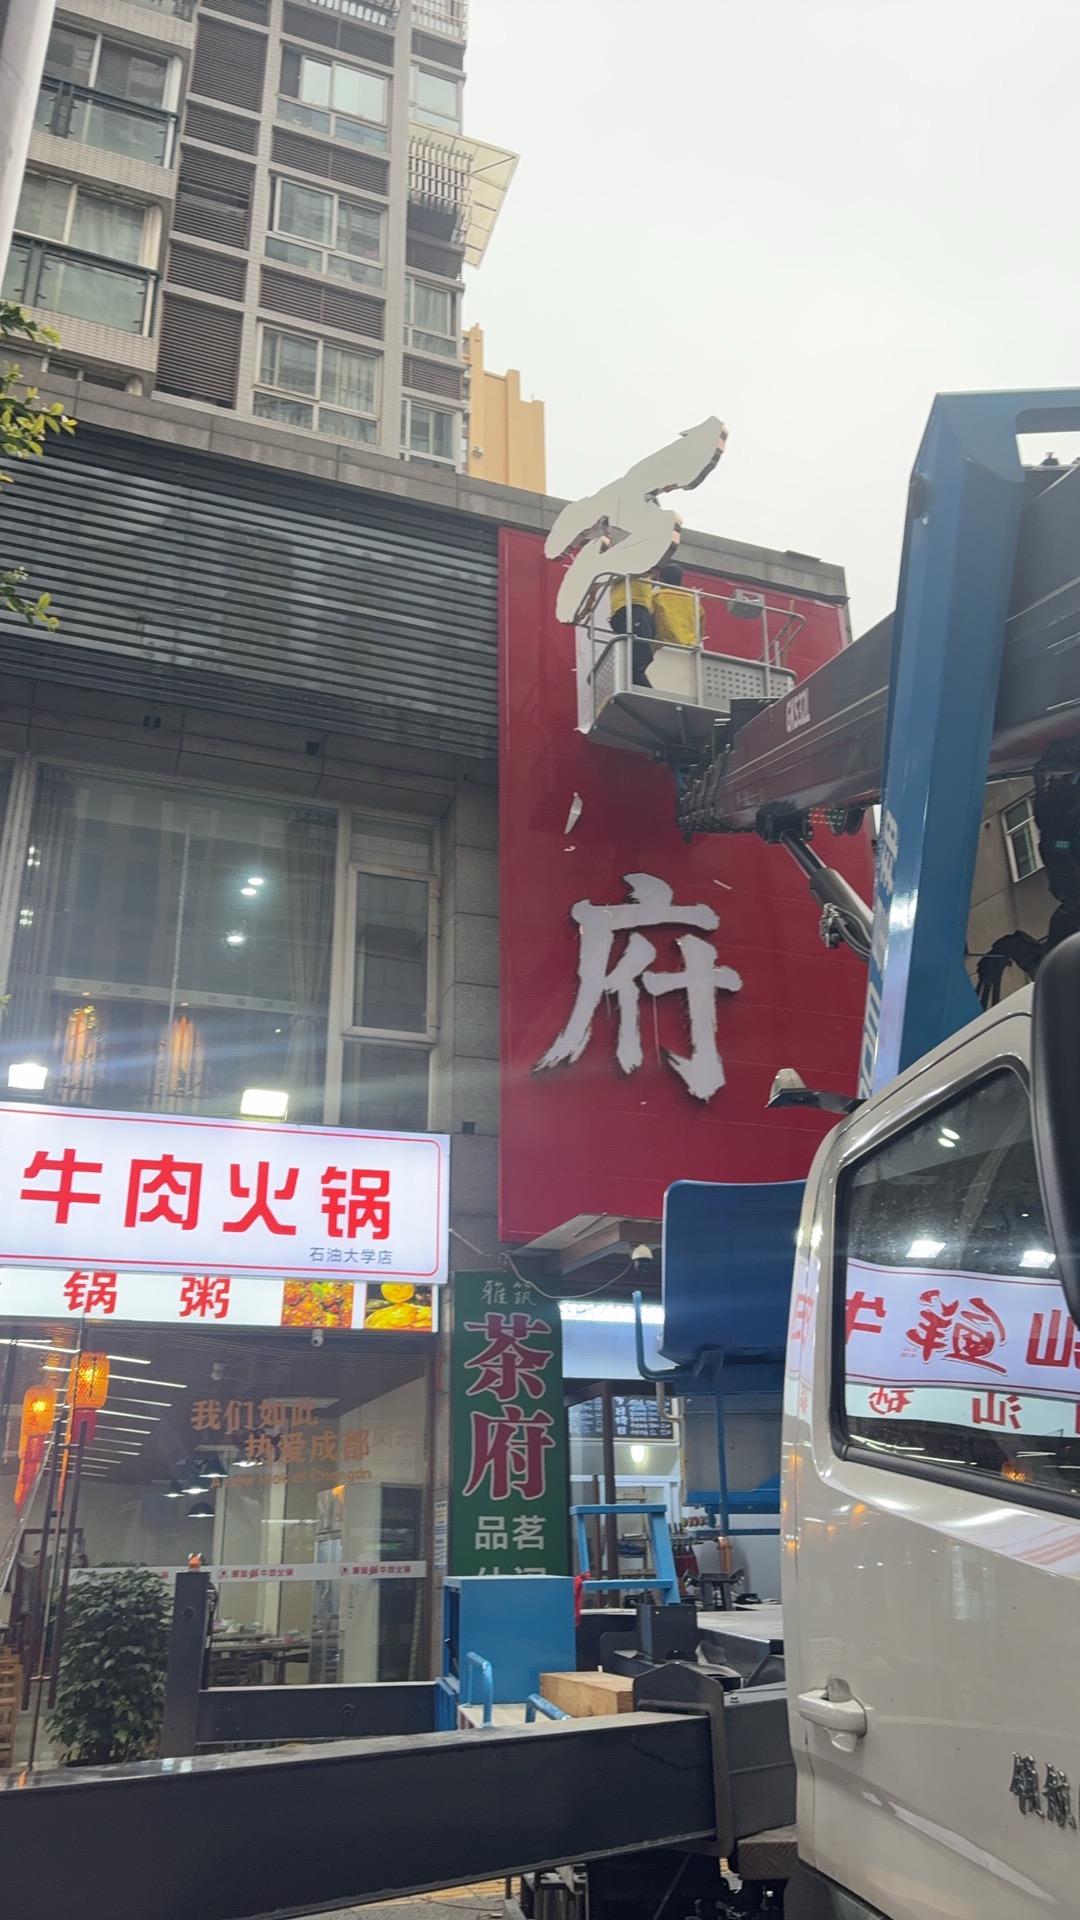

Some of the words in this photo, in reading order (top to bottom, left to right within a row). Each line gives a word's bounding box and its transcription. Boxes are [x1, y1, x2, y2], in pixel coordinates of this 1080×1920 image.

[530, 872, 743, 1104] 府
[20, 1148, 391, 1240] 牛肉火锅
[309, 1247, 393, 1265] 石油大学店
[63, 1271, 232, 1319] 锅粥
[190, 1397, 319, 1434] 我们如此
[462, 1312, 555, 1501] 茶府
[245, 1428, 370, 1464] 热爱成都
[475, 1515, 547, 1550] 品茗
